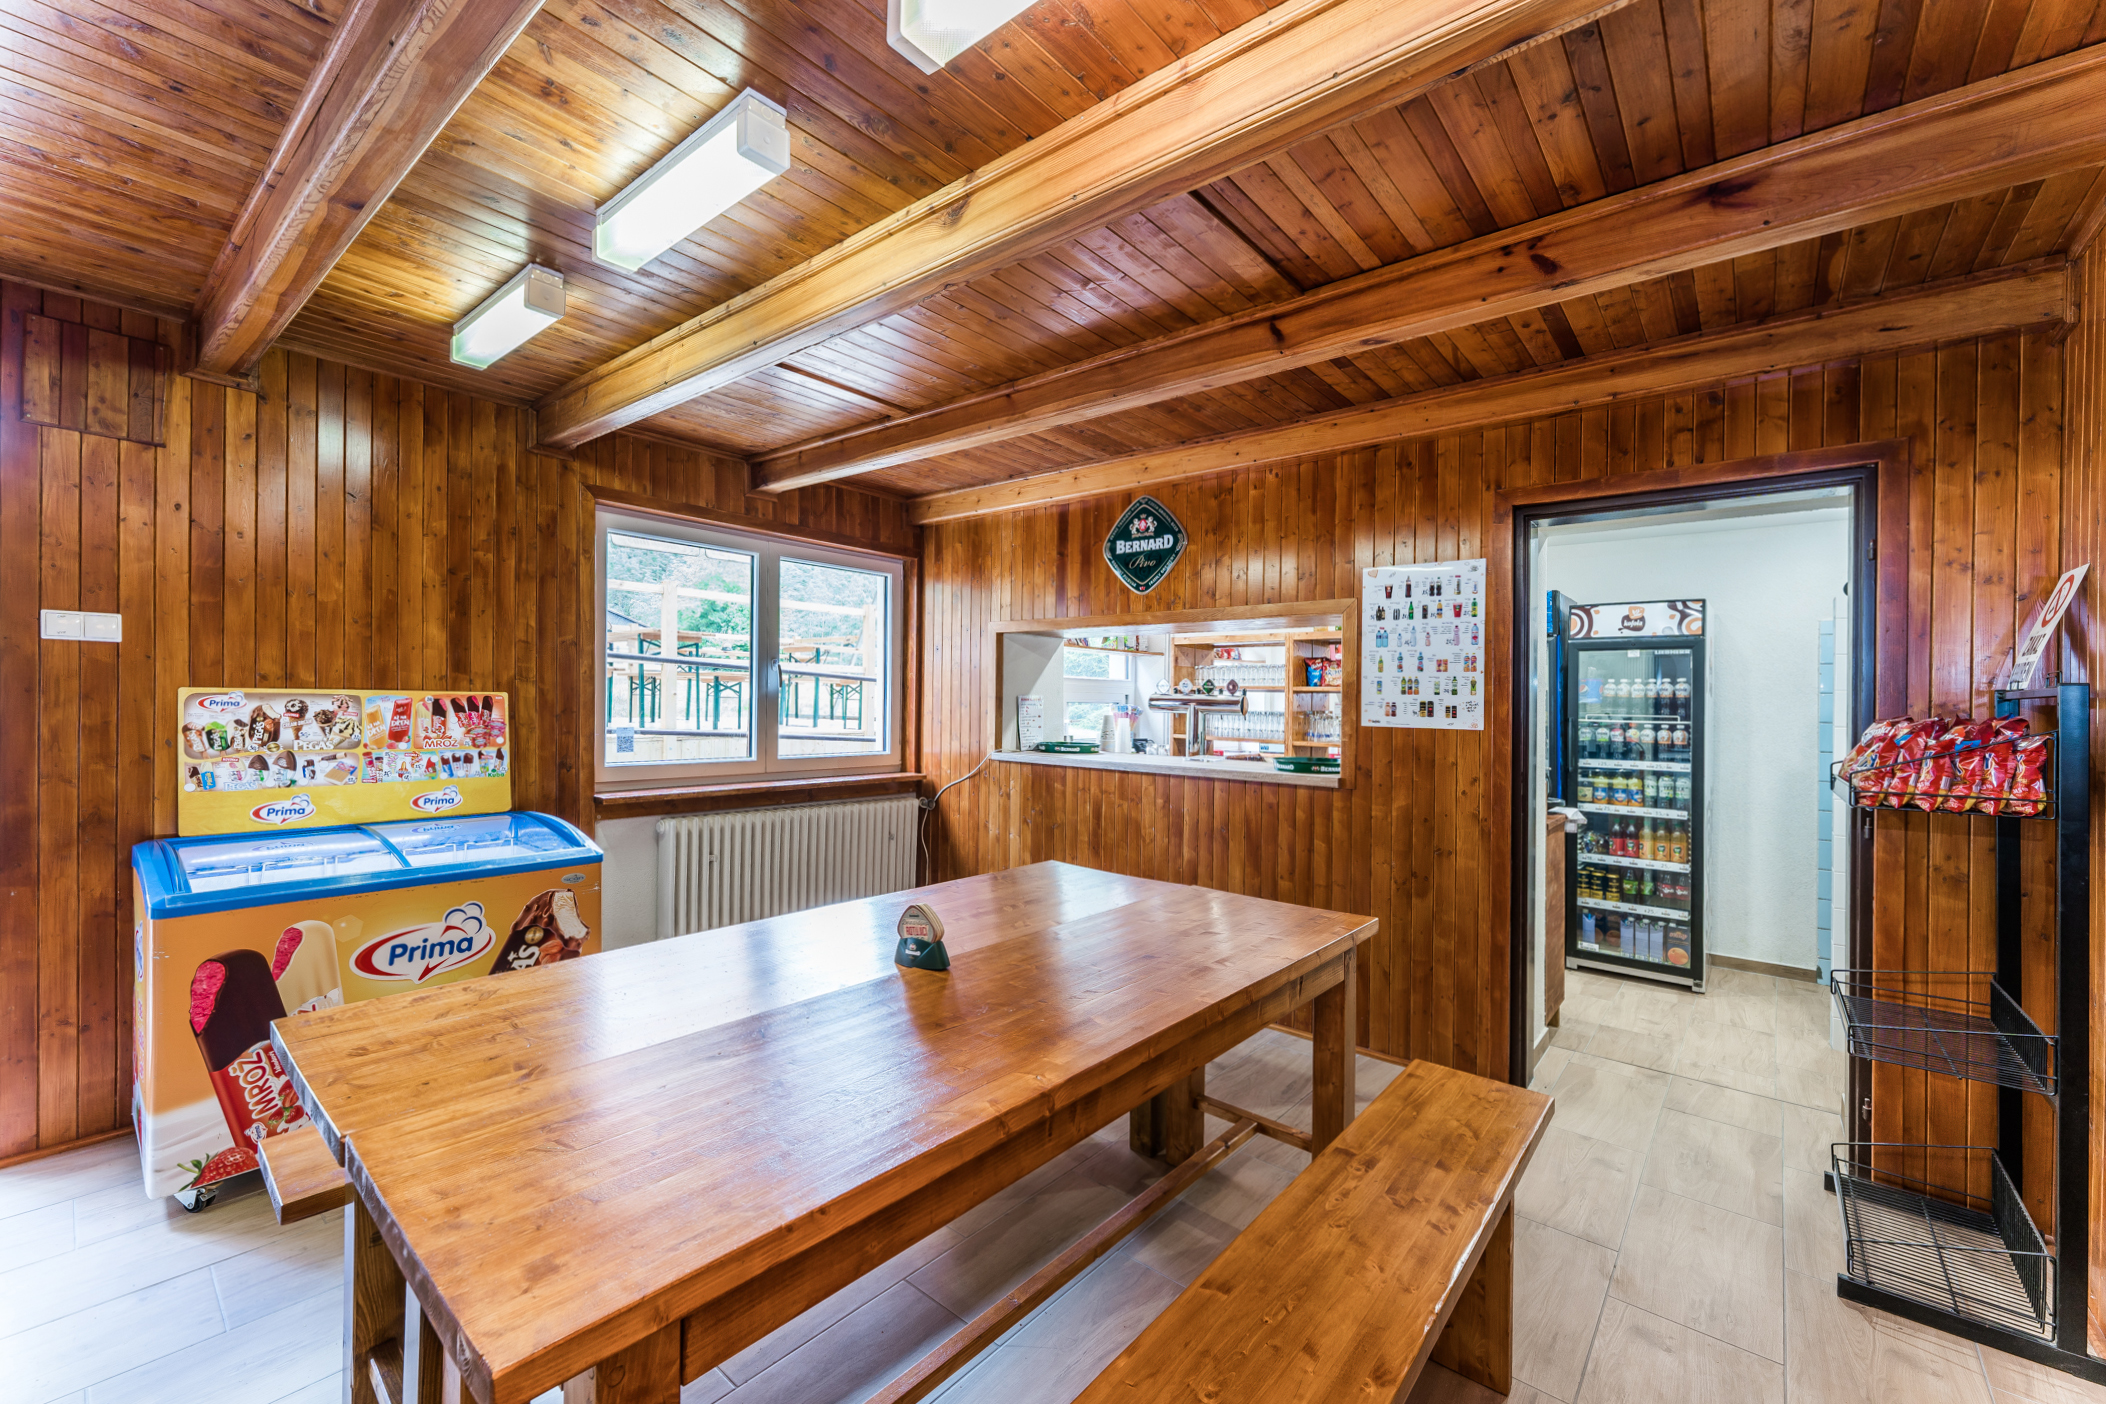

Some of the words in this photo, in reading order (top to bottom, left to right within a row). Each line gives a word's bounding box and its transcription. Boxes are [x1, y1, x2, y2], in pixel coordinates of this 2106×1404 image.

[1115, 534, 1174, 555] BERNARD
[1129, 553, 1156, 569] Pivo
[1623, 618, 1643, 628] kofola
[209, 699, 240, 707] Prima
[253, 721, 265, 744] PEGAS
[293, 740, 334, 751] PEGAS
[423, 796, 455, 806] Prima
[267, 806, 305, 817] Prima
[388, 936, 474, 967] Prima
[229, 1050, 279, 1118] MROŽ
